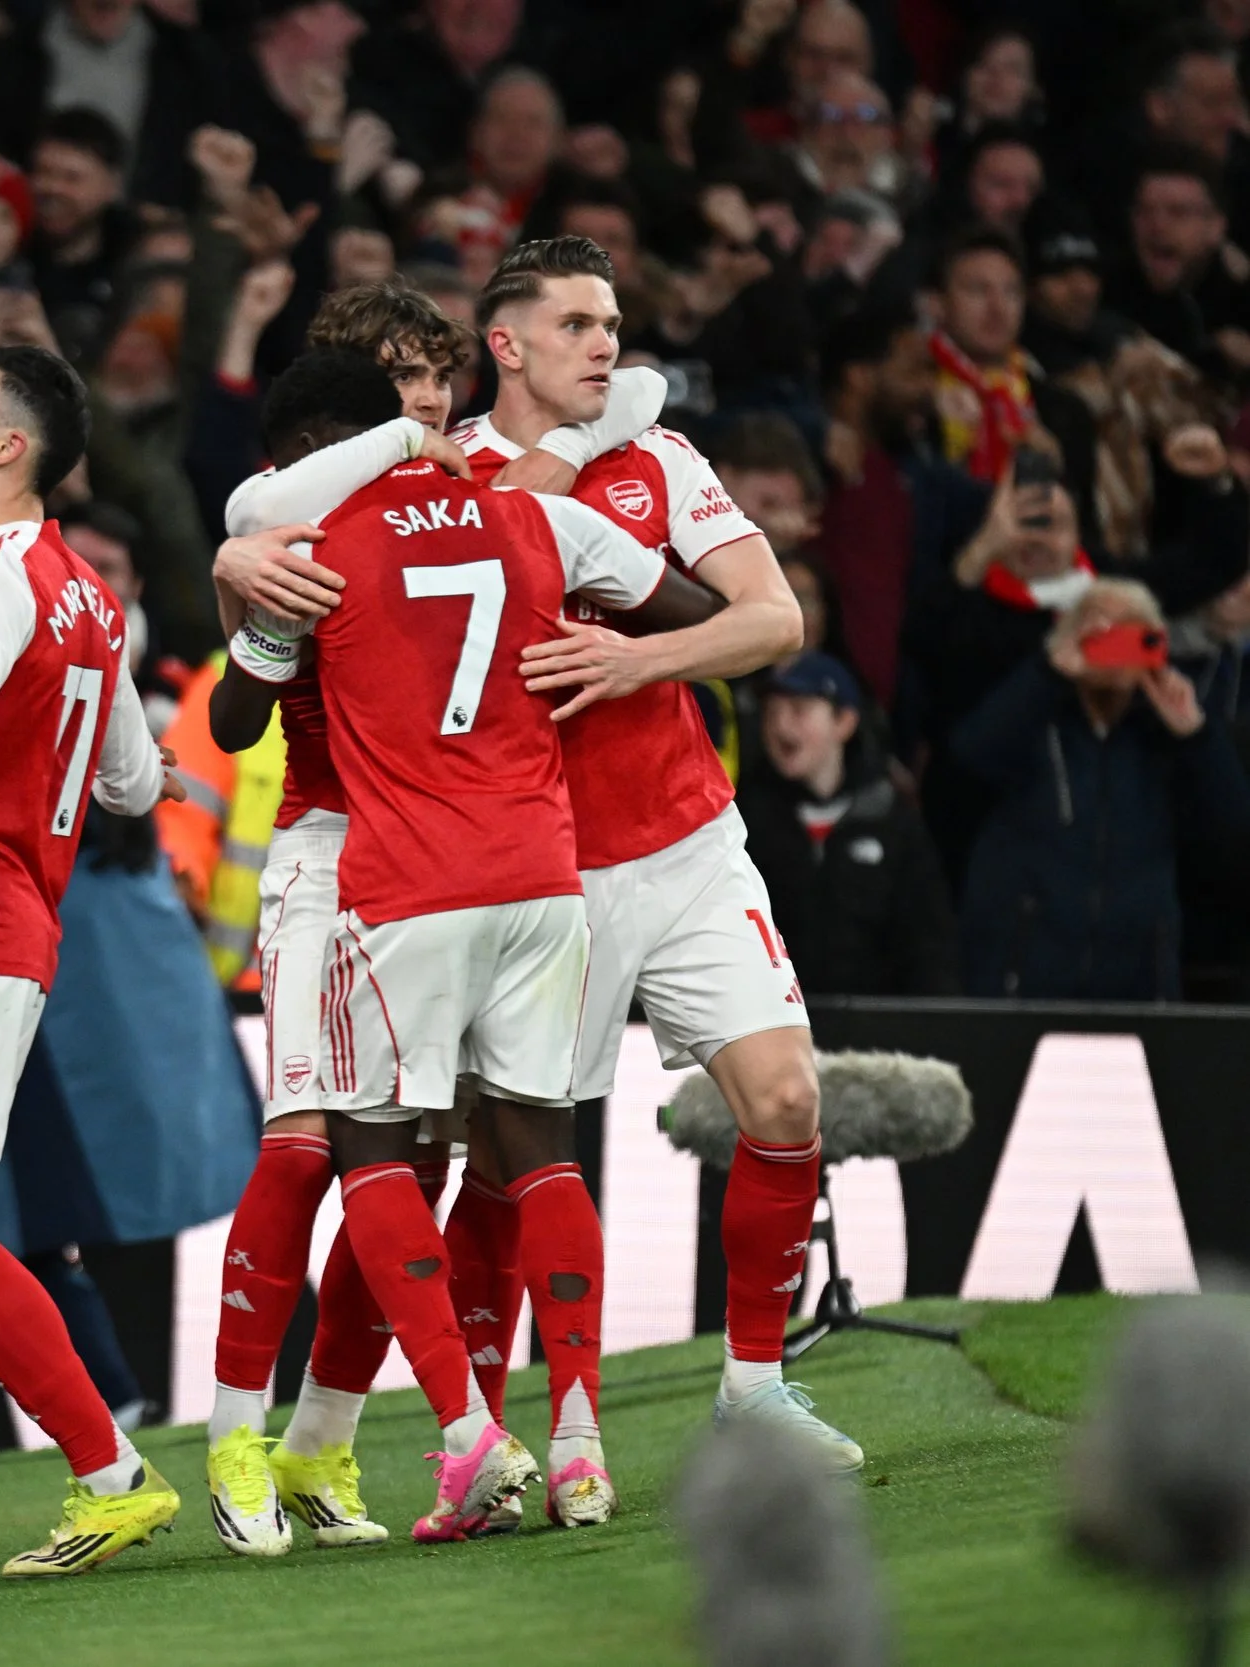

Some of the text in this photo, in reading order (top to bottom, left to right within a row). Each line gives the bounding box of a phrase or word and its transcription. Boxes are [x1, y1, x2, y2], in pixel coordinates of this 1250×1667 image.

[613, 486, 645, 498] Arsenal
[383, 499, 483, 537] SAKA
[243, 625, 292, 656] aptain
[403, 559, 507, 735] 7
[744, 909, 789, 968] 1
